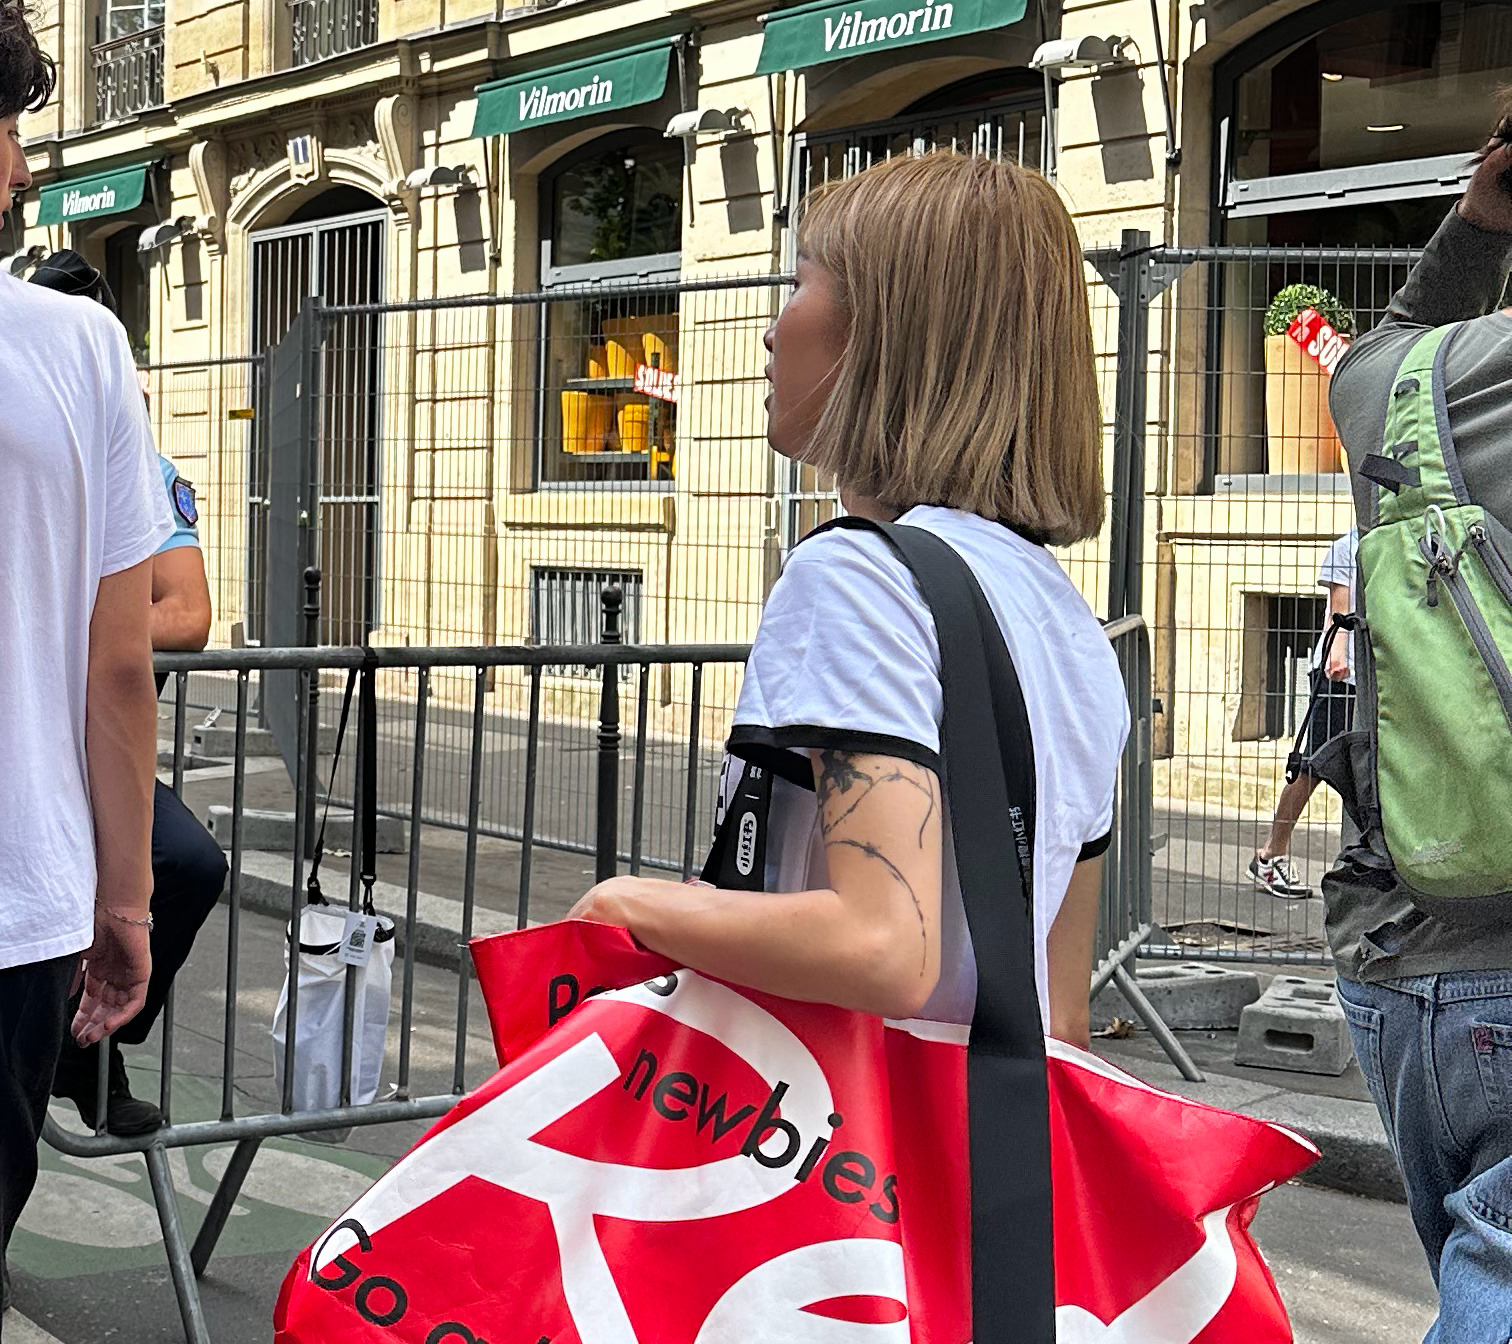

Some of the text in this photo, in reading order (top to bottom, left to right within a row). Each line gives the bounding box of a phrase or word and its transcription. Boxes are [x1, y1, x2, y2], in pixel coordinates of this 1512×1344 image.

[519, 74, 613, 122] Vilmorin
[62, 185, 116, 217] Vilmorin
[740, 819, 755, 868] 小红书
[622, 1047, 901, 1225] newbies
[310, 1218, 409, 1328] Go
